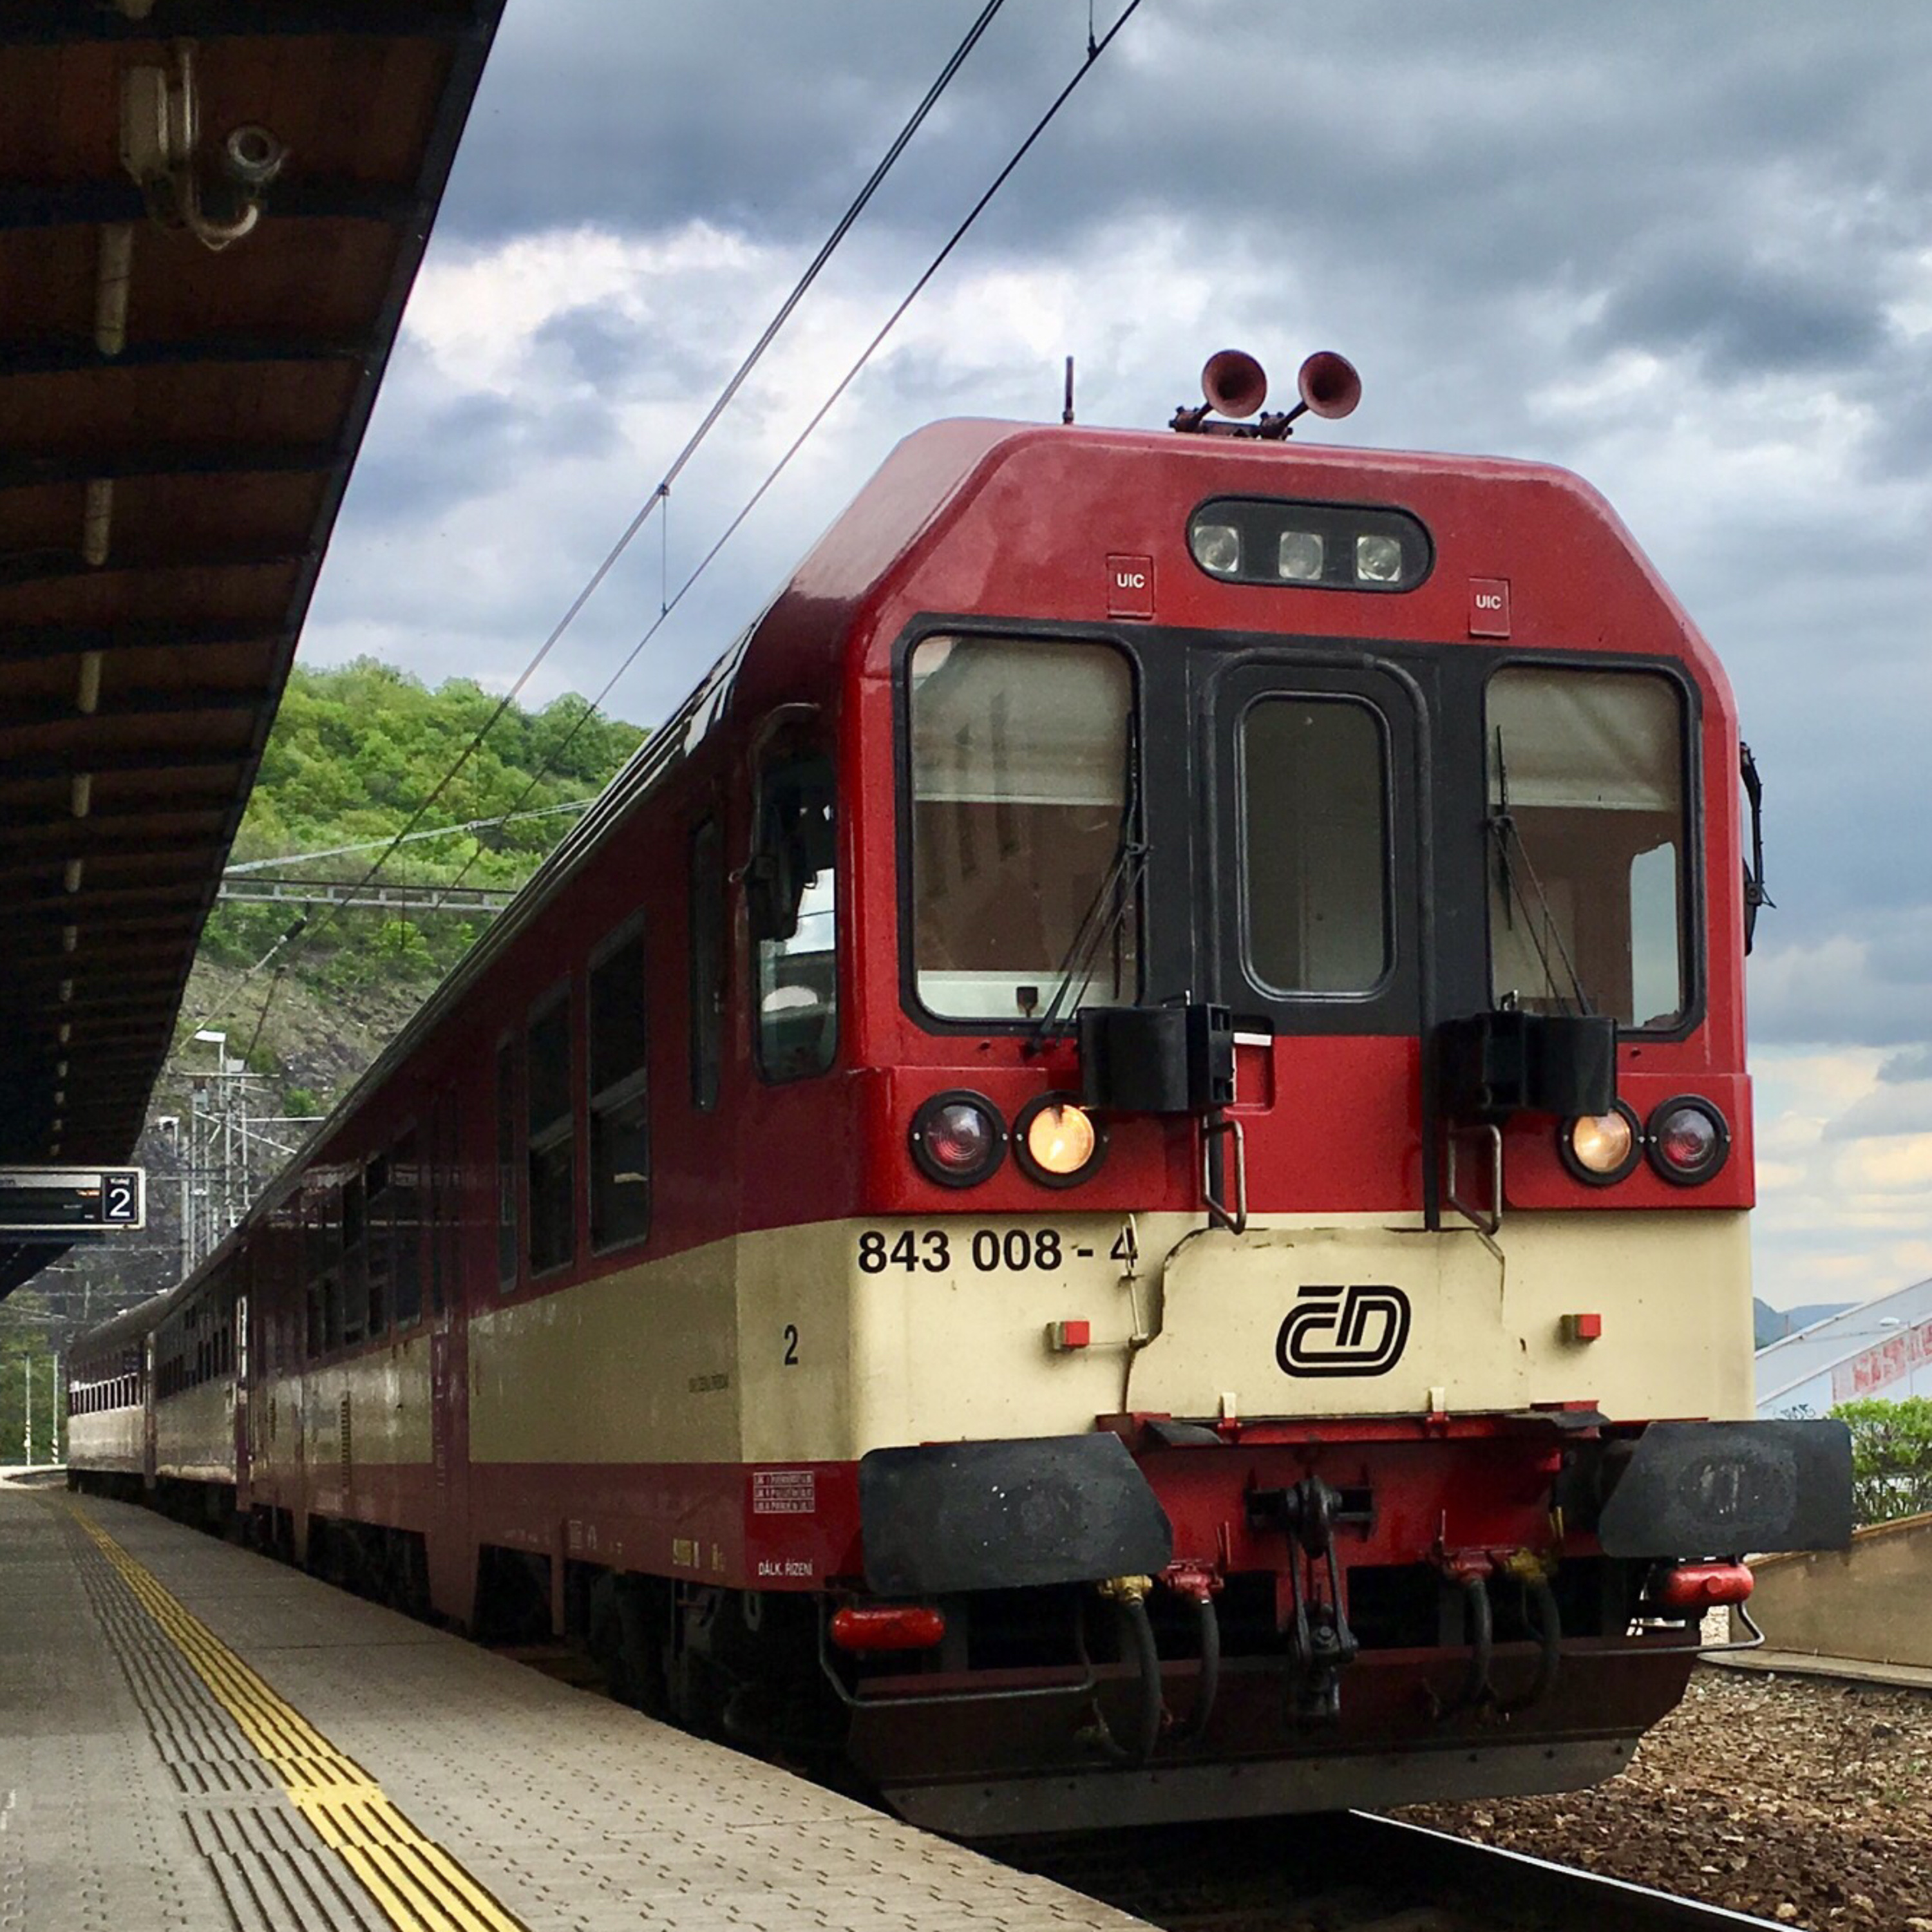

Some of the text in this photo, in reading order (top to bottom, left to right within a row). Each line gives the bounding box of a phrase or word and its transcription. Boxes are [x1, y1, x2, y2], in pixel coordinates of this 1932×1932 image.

[1117, 573, 1144, 589] UIC
[1476, 594, 1501, 610] UIC
[109, 1188, 130, 1217] 2
[858, 1230, 951, 1274] 843
[784, 1324, 799, 1365] 2
